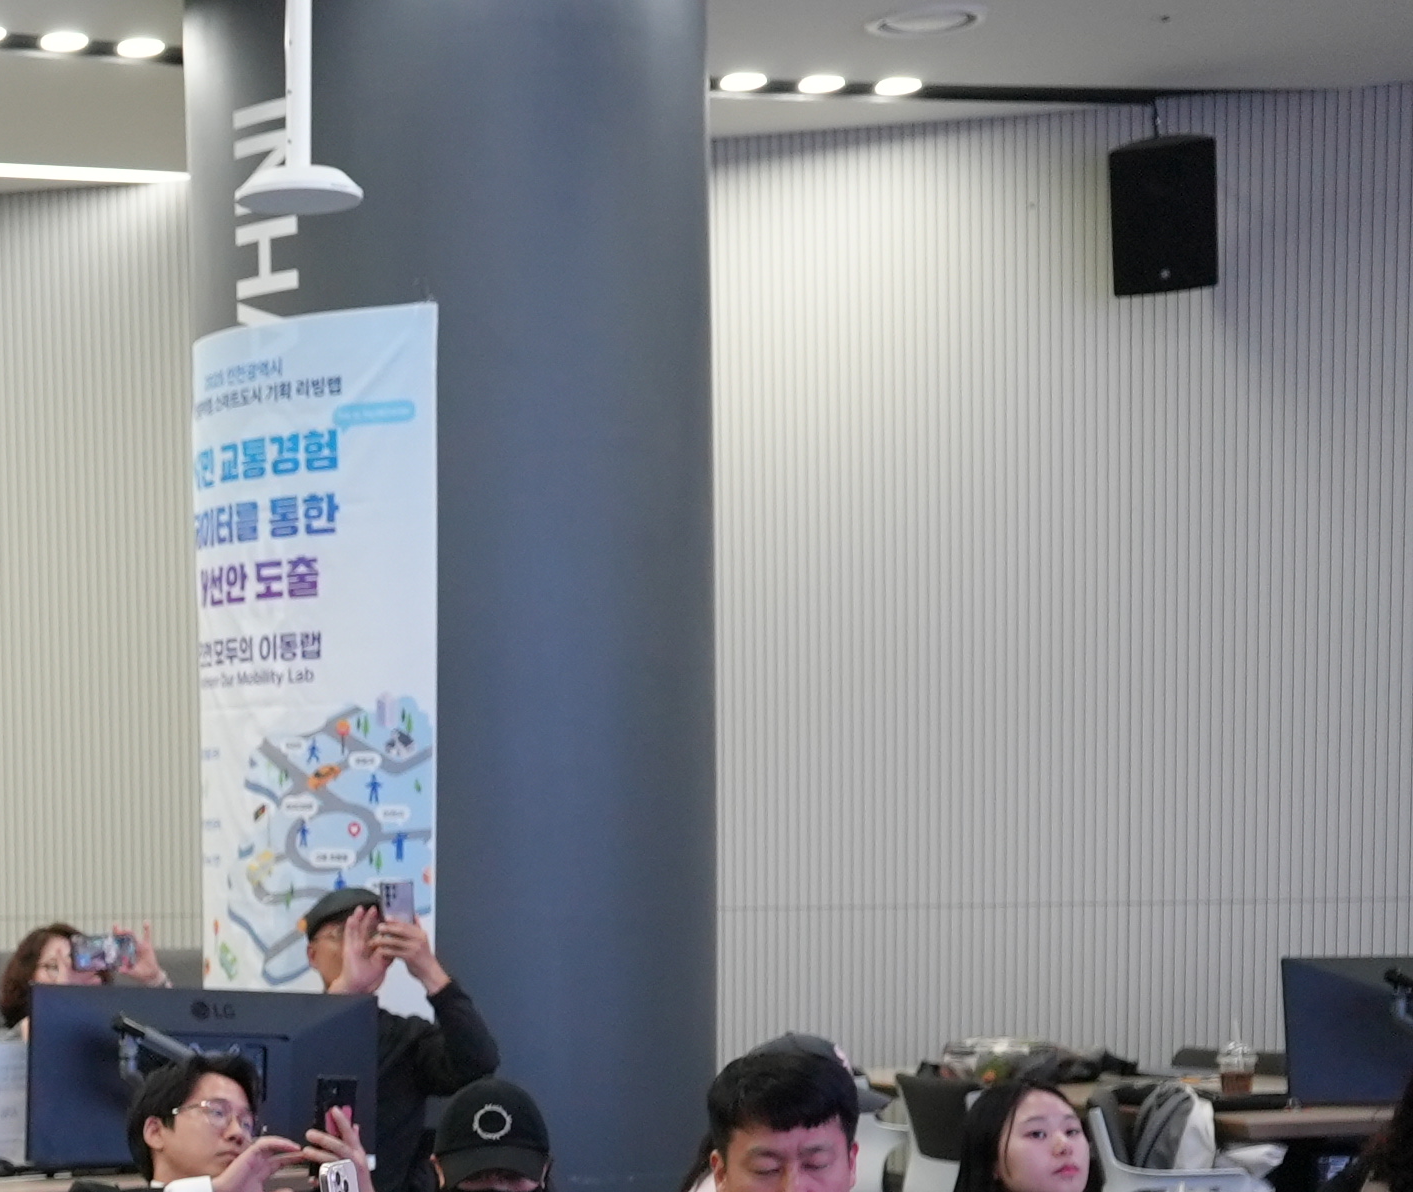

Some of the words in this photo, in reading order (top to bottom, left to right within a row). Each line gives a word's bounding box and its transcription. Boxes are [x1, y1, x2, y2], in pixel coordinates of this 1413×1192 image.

[295, 376, 341, 399] 리빙랩
[220, 428, 339, 483] 교통경험
[269, 493, 339, 538] 통한
[255, 556, 319, 599] 도출
[214, 635, 253, 665] 모두의
[259, 631, 321, 662] 이동랩
[288, 667, 315, 684] Lab
[213, 1003, 236, 1020] LG
